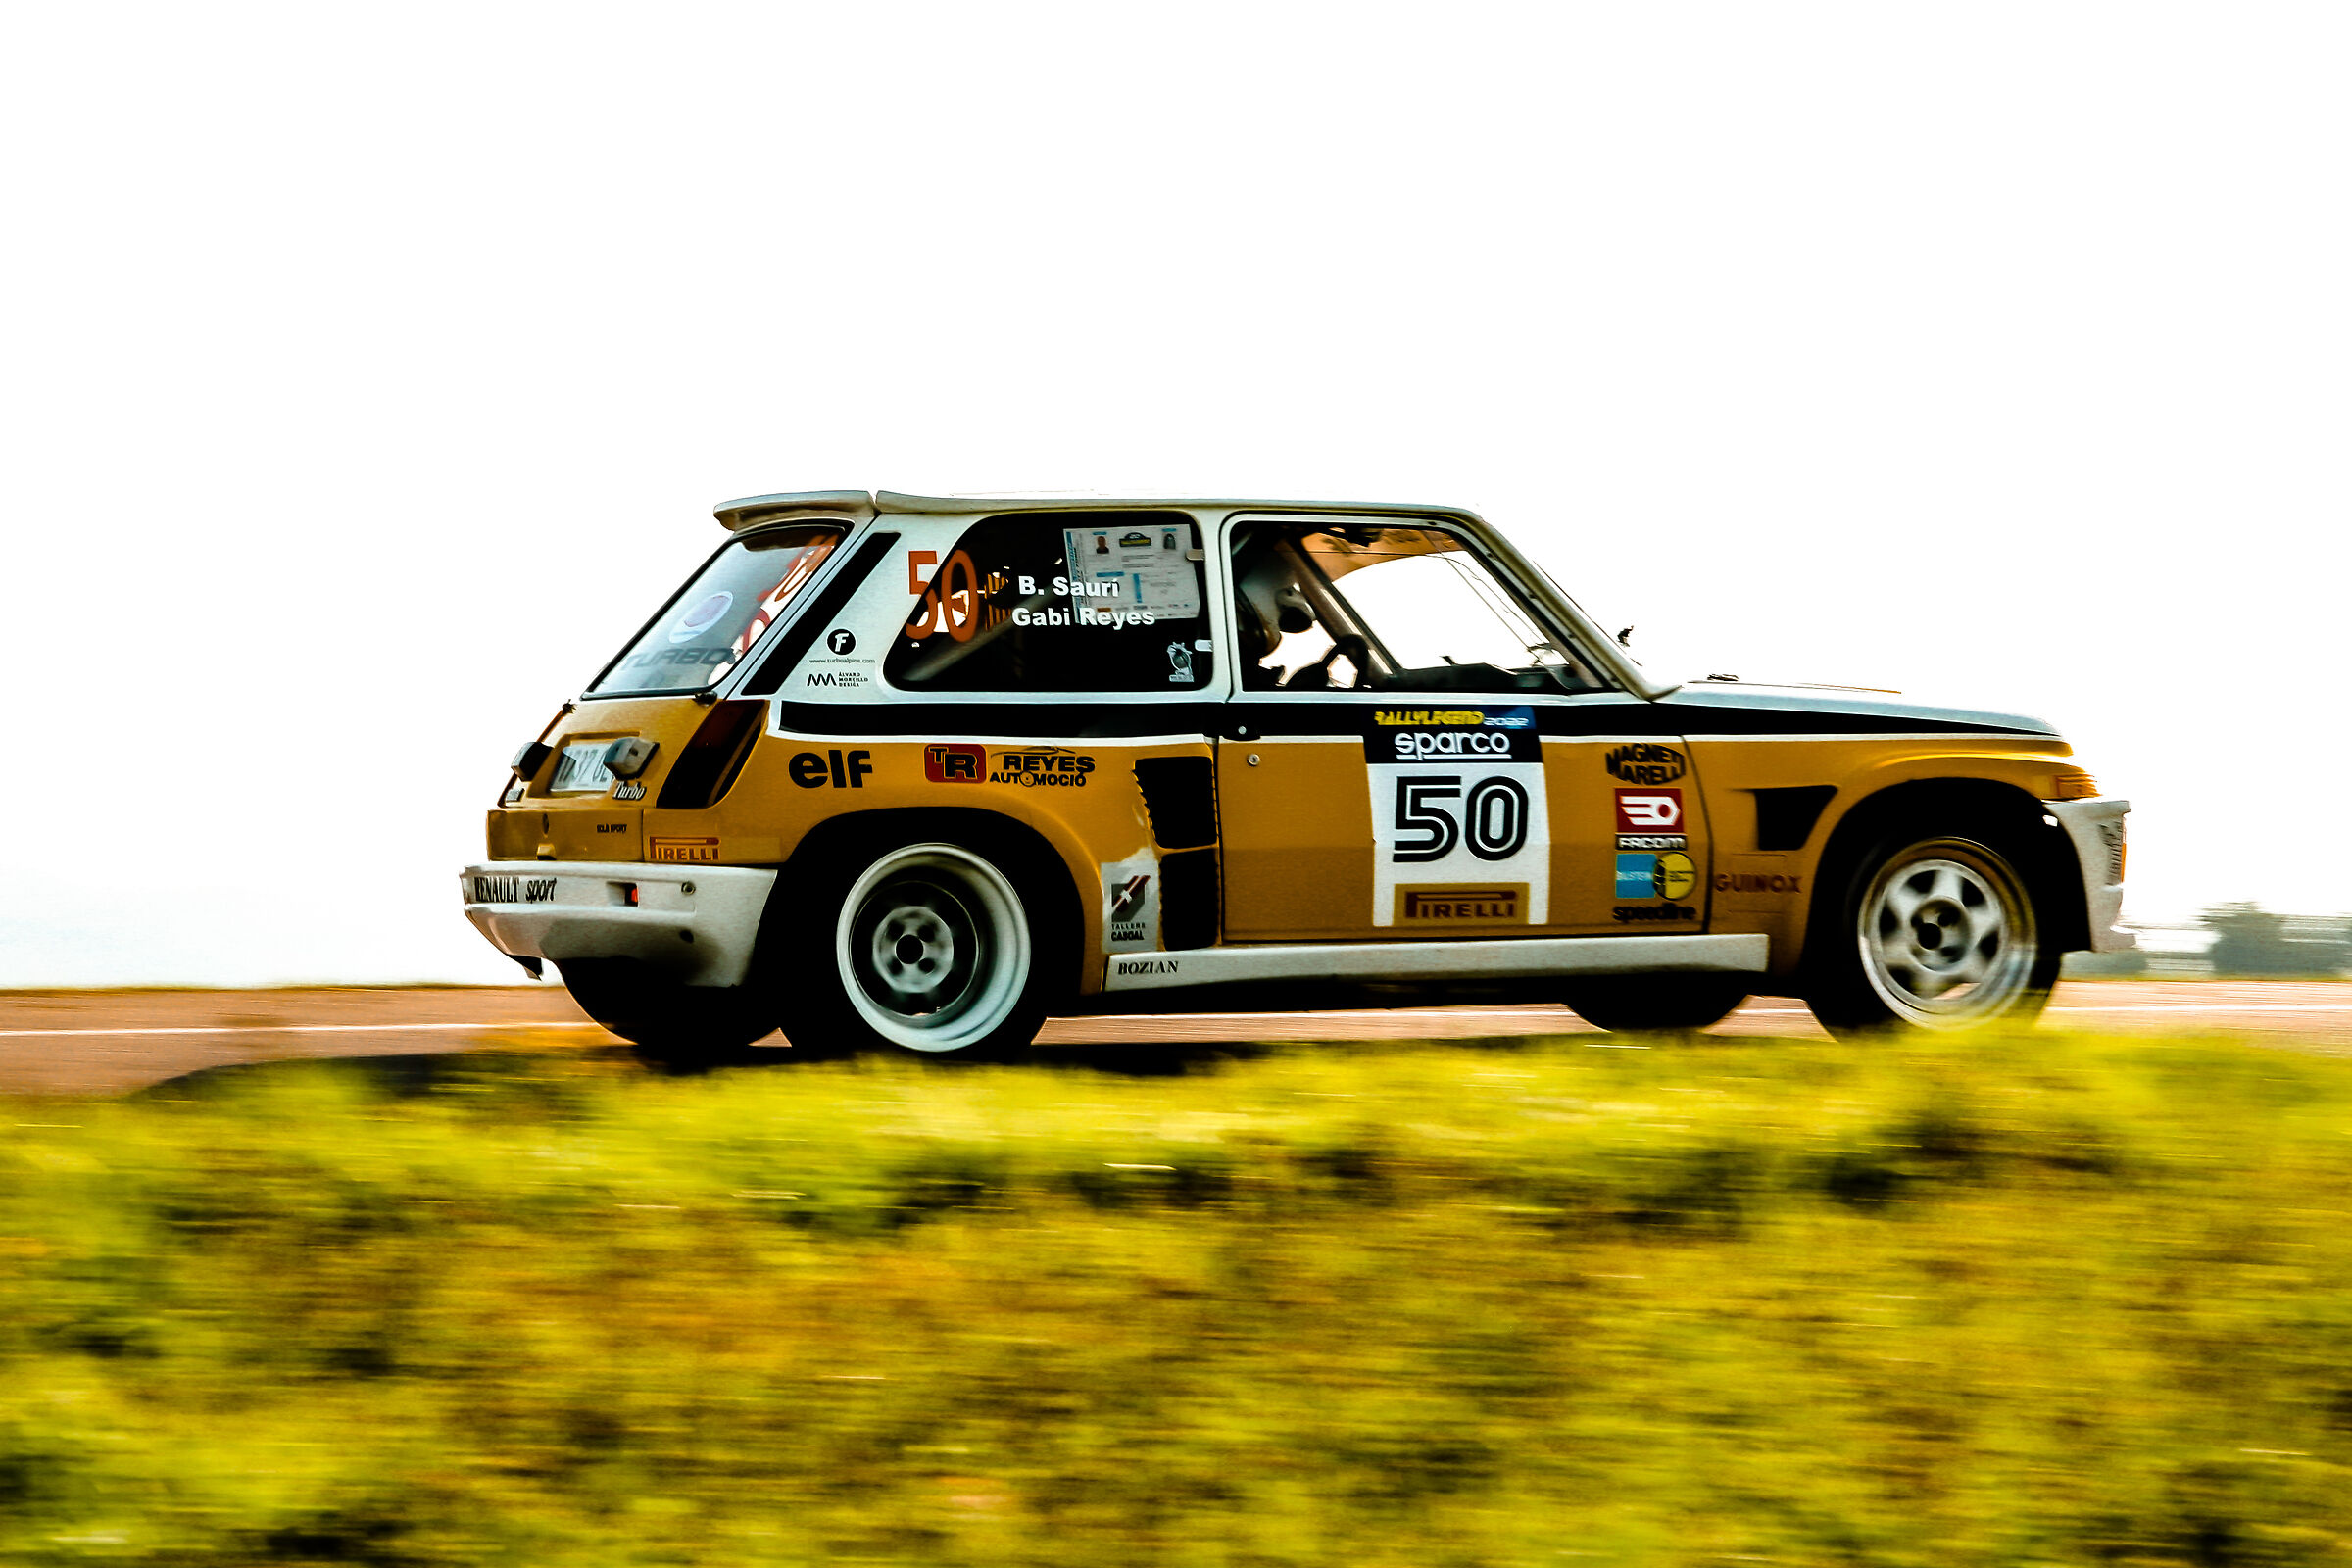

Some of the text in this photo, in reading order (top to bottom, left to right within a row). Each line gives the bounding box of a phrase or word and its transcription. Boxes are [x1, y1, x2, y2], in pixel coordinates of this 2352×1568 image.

[906, 550, 977, 643] 50
[1018, 575, 1045, 596] B.
[1011, 607, 1155, 630] Gabi Reyes
[1484, 717, 1529, 726] 2022
[1394, 732, 1512, 761] sparco
[788, 749, 873, 789] elf
[1003, 755, 1096, 773] REYES
[612, 781, 647, 802] Turbo
[1393, 775, 1529, 863] 50
[649, 837, 720, 860] PIRELLI
[1619, 837, 1685, 849] FACOM
[474, 876, 557, 904] RENAULT sport
[1715, 874, 1801, 894] GUINOX
[1405, 891, 1516, 918] PIRELLI
[1118, 960, 1179, 975] BOZIAN
